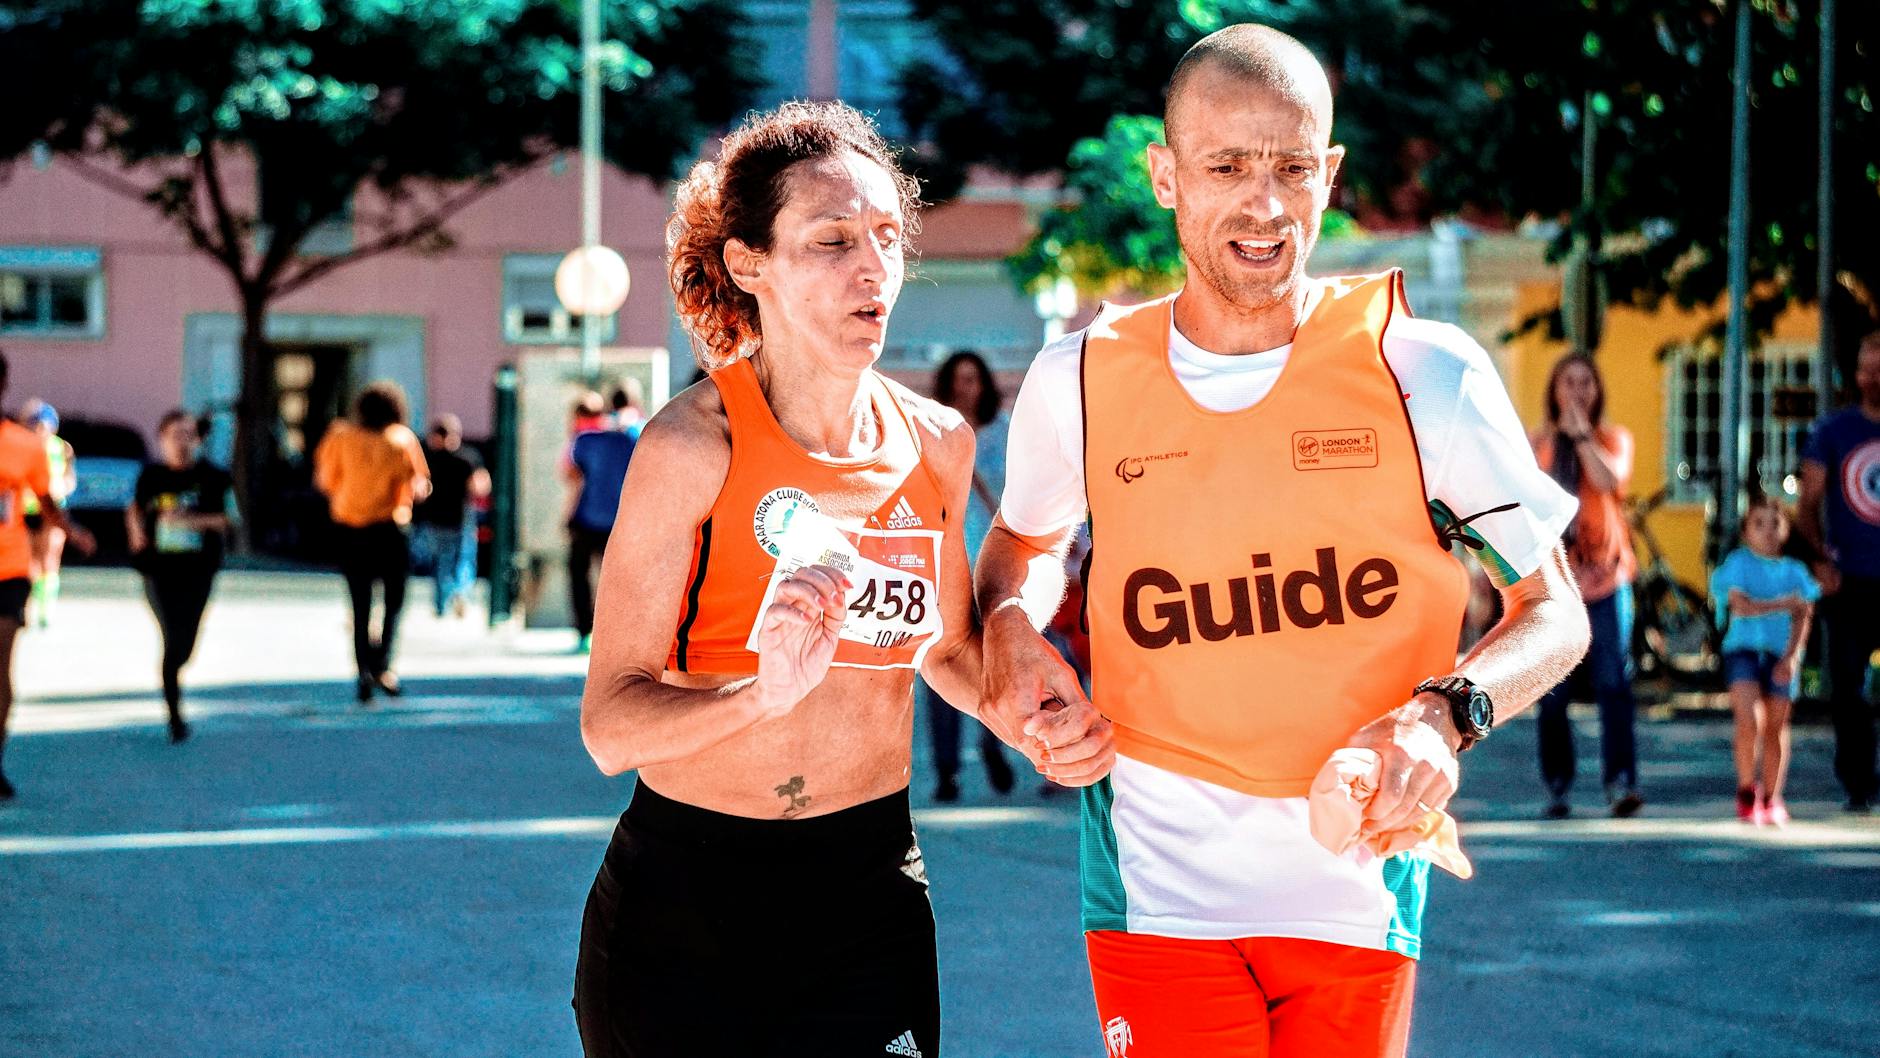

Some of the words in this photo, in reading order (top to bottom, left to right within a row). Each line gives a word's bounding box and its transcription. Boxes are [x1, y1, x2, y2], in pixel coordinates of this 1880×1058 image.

[1322, 438, 1360, 447] LONDON
[1144, 451, 1189, 462] ATHLETICS
[1322, 445, 1373, 455] MARATHON
[755, 495, 777, 546] MARATONA
[776, 489, 804, 501] CLUBE
[887, 516, 923, 529] adidas
[848, 578, 926, 625] 458
[1122, 547, 1399, 649] Guide
[885, 1044, 922, 1058] adidas
